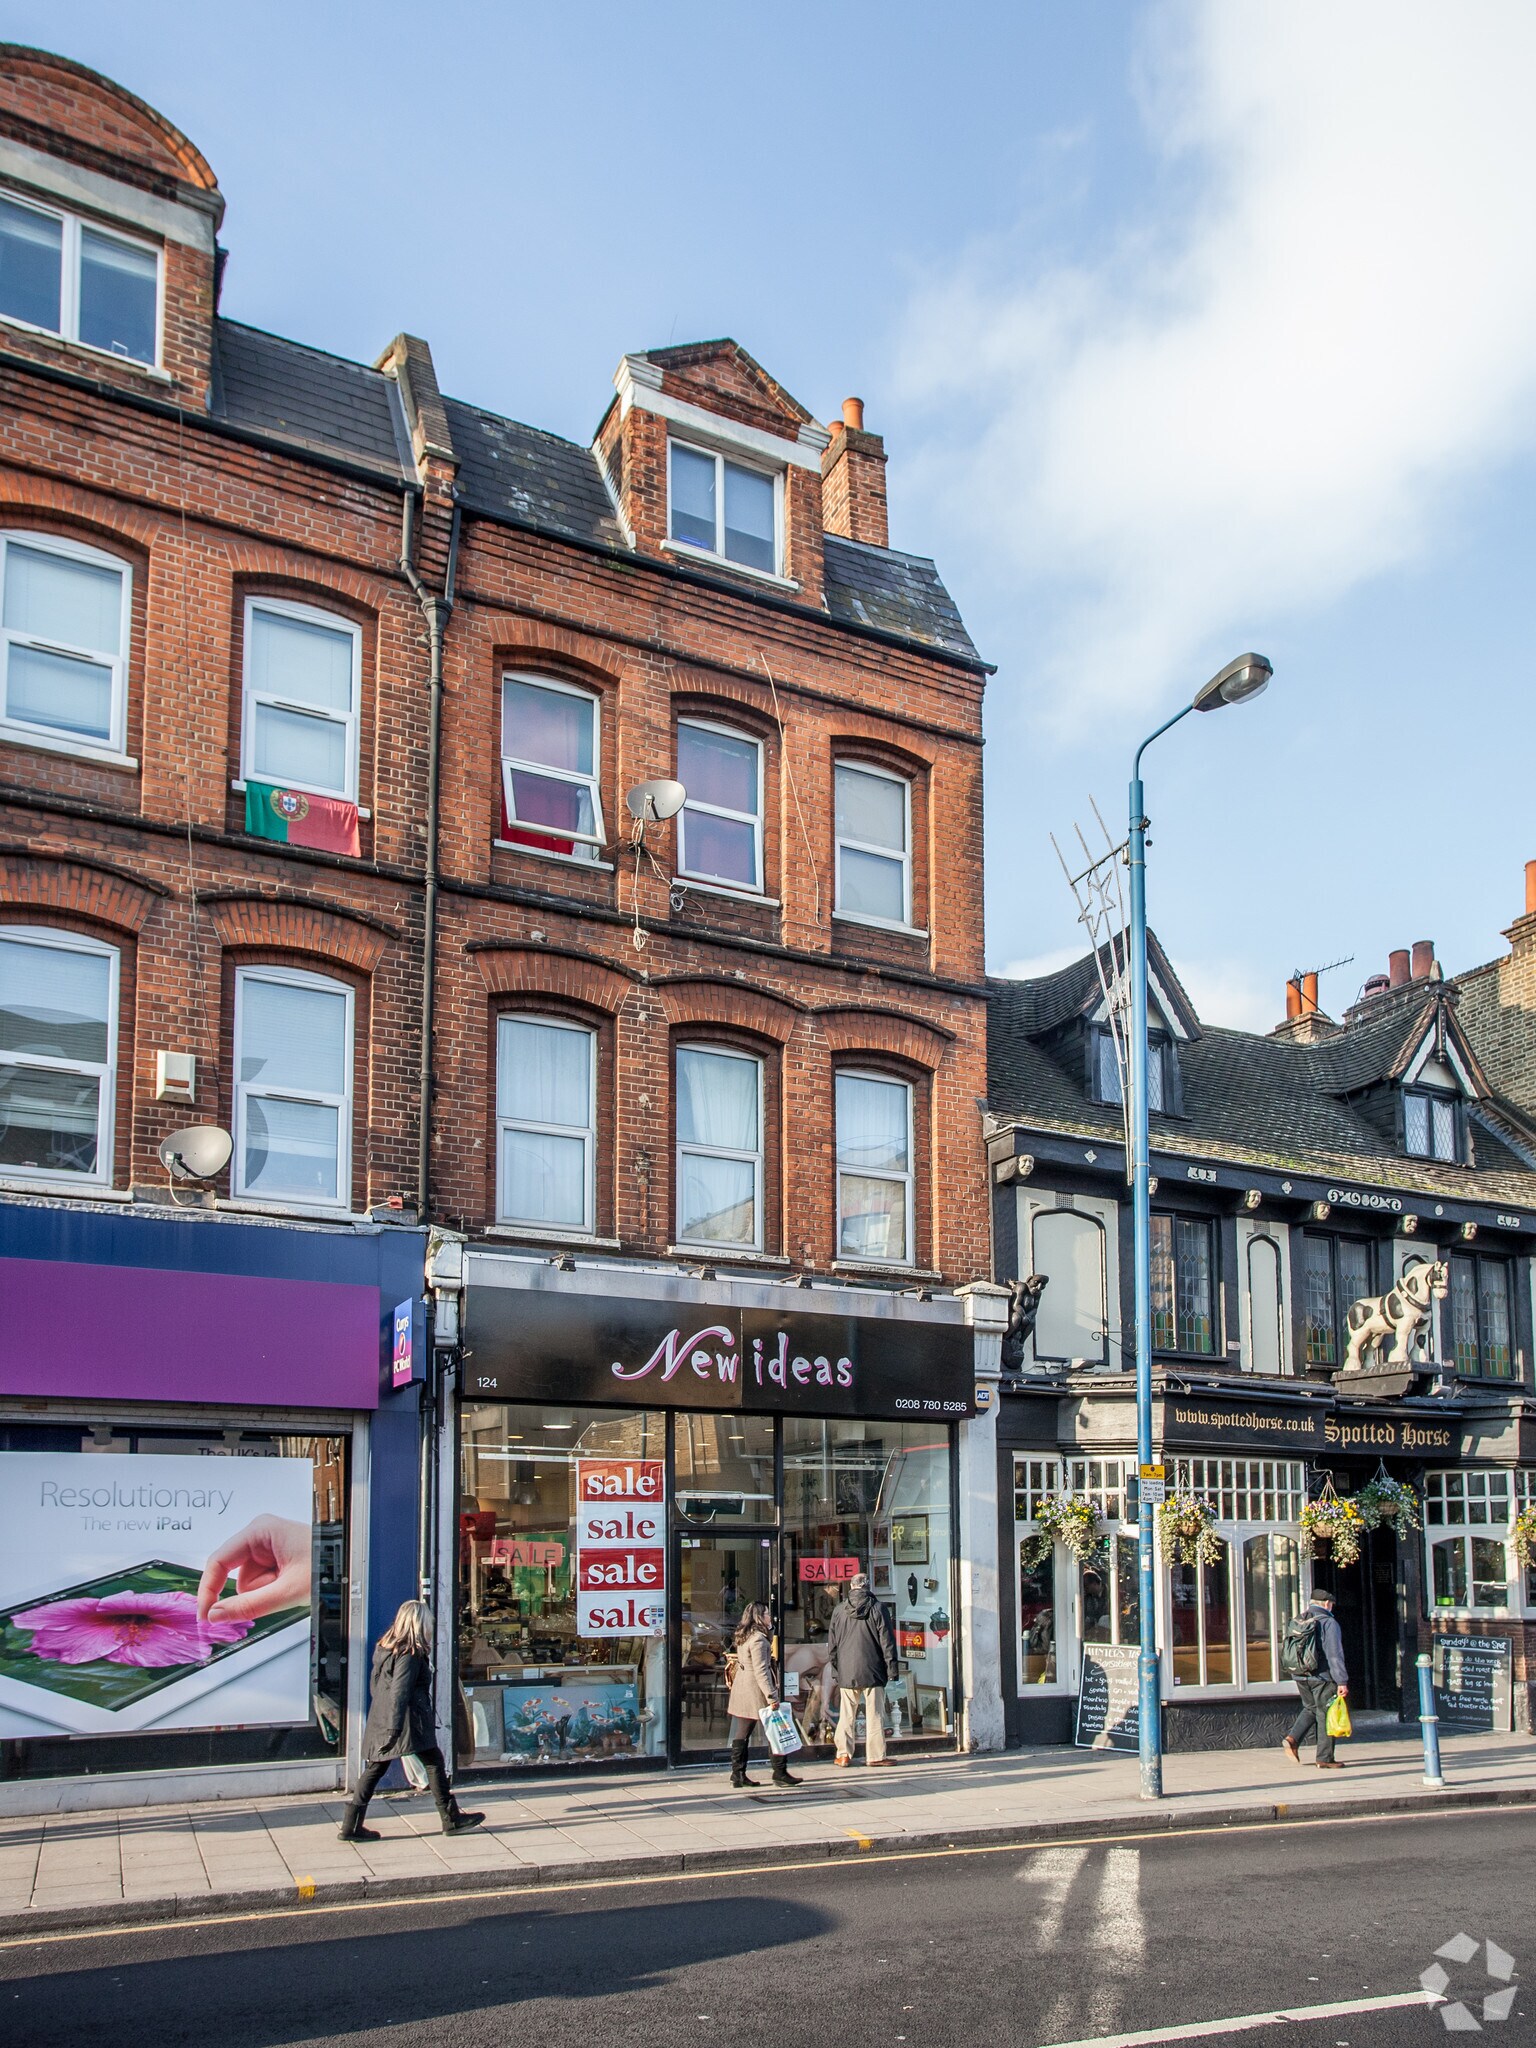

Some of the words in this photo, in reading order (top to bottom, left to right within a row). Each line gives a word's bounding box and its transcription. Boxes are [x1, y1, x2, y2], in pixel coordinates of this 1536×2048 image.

[611, 1325, 740, 1382] New
[752, 1332, 853, 1389] ideas
[477, 1377, 498, 1388] 124
[895, 1398, 920, 1409] 0208
[922, 1400, 941, 1410] 780
[943, 1401, 967, 1411] 5285
[1175, 1408, 1315, 1433] www.spottedhorse.co.uk
[1325, 1417, 1395, 1449] Spotted
[1401, 1422, 1451, 1450] Horse
[587, 1466, 655, 1496] sale
[40, 1480, 234, 1515] Resolutionary
[81, 1516, 112, 1531] The
[117, 1519, 150, 1531] new
[156, 1516, 192, 1531] iPad
[587, 1511, 656, 1540] sale
[497, 1547, 556, 1564] SALE
[587, 1554, 657, 1585] sale
[804, 1564, 854, 1579] SALE
[588, 1600, 650, 1629] sale
[1478, 1639, 1490, 1649] the
[1491, 1640, 1507, 1650] Spot
